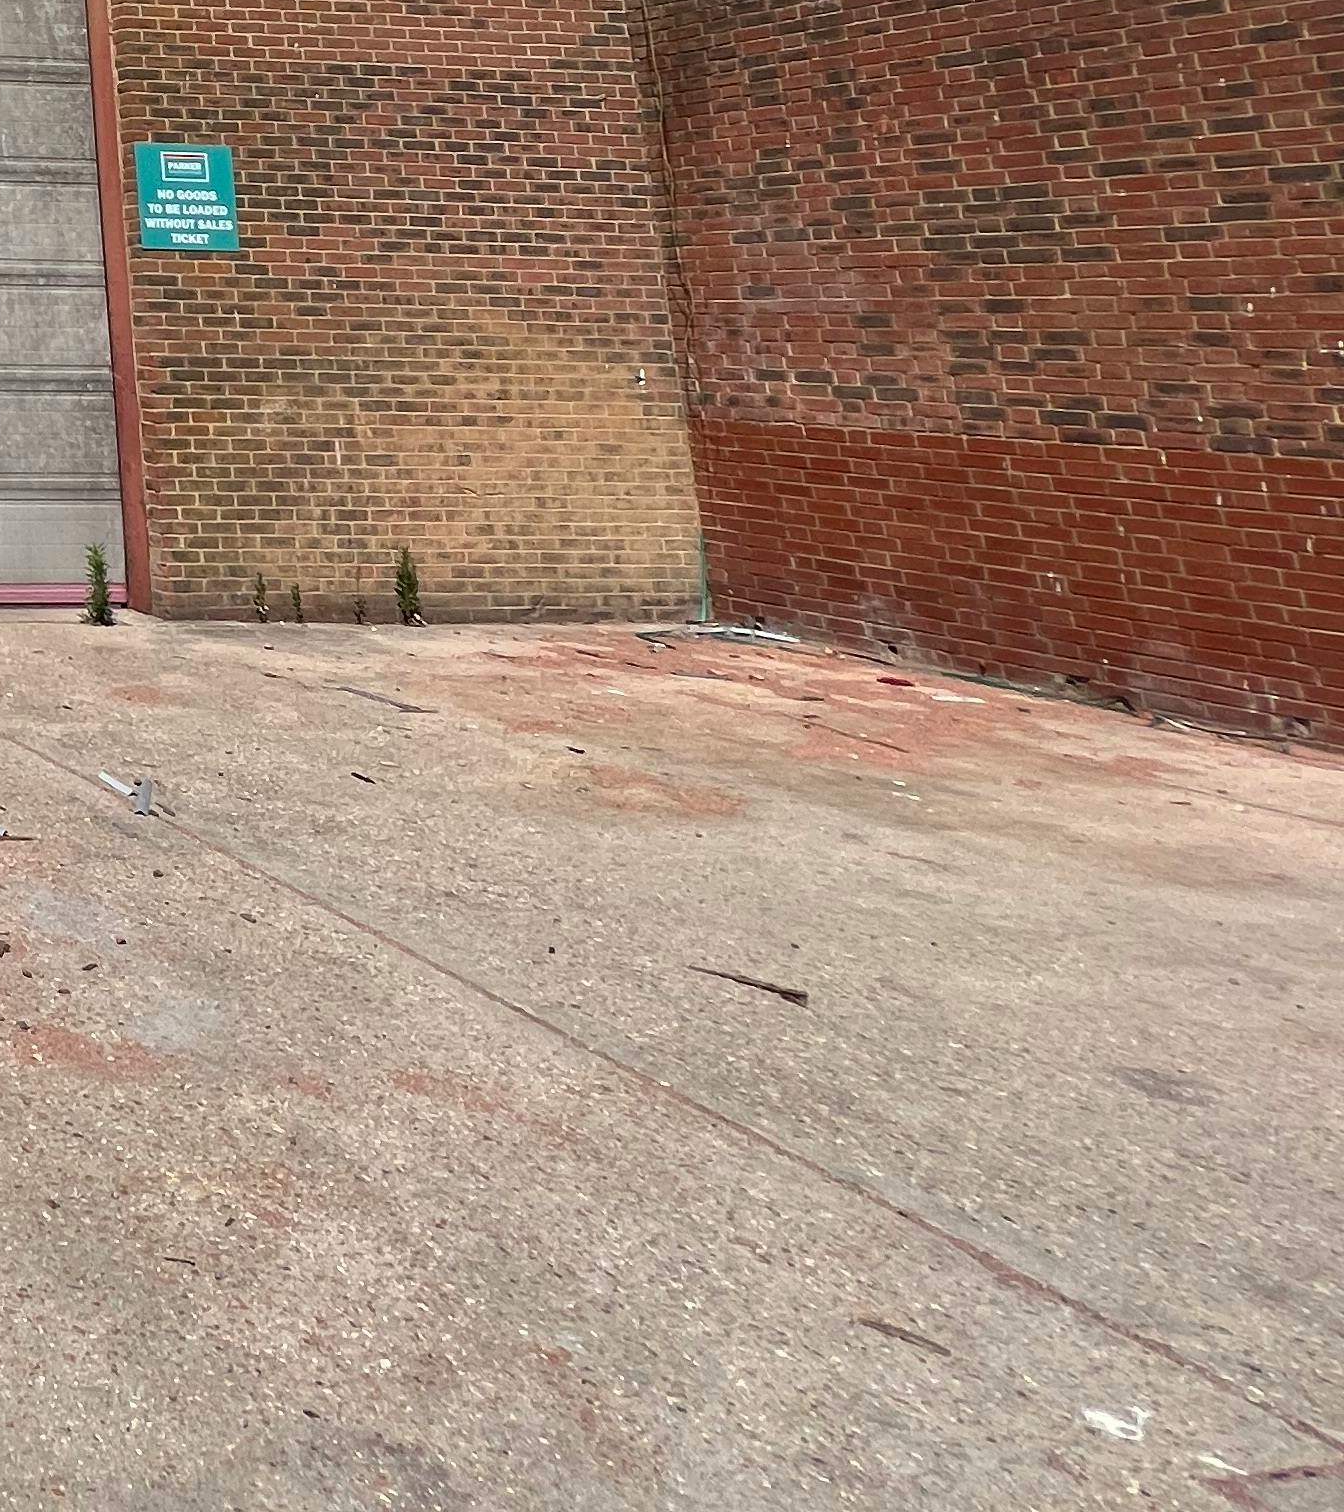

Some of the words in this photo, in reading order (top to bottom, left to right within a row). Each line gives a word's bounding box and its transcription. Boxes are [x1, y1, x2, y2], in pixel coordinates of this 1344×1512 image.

[168, 162, 201, 170] PARKER
[157, 189, 174, 199] NO
[177, 190, 217, 201] GOODS
[147, 203, 162, 213] TO
[166, 204, 180, 214] BE
[183, 204, 228, 215] LOADED
[145, 218, 195, 229] WITHOUT
[198, 219, 233, 230] SALES
[171, 233, 209, 244] TICKET
